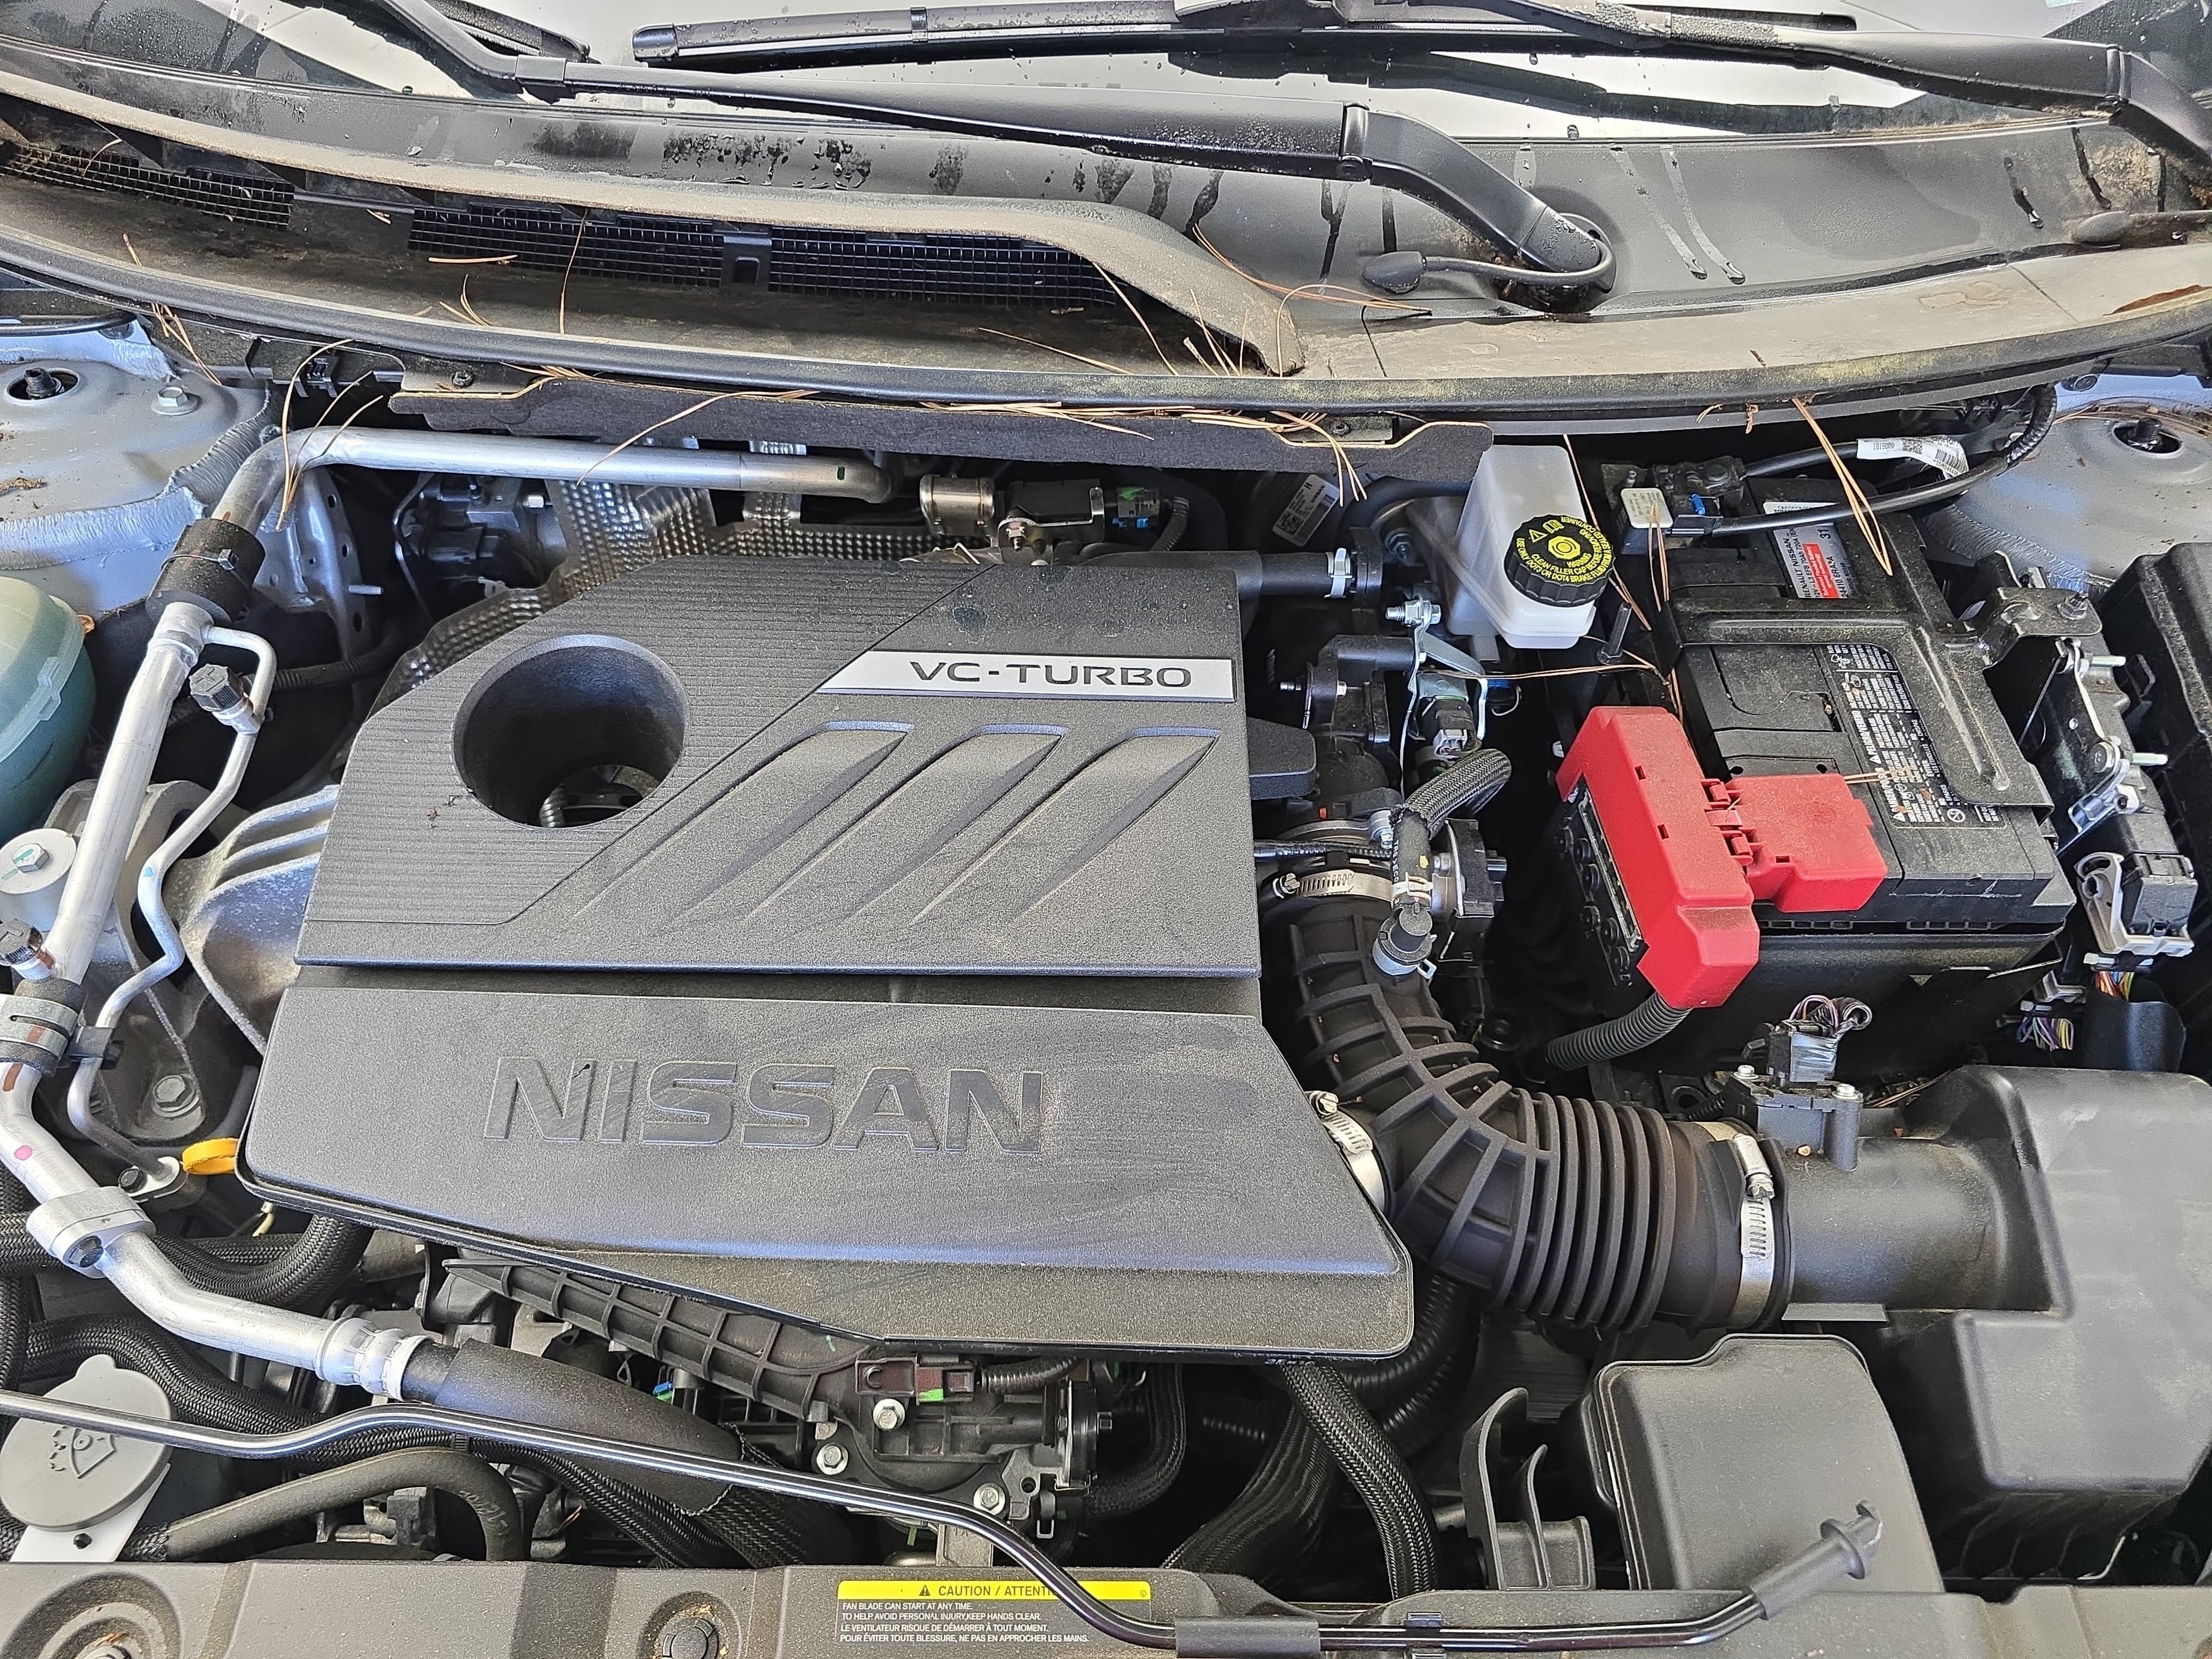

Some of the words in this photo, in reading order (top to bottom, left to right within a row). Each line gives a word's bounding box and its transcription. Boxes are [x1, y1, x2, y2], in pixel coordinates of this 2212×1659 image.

[1561, 516, 1596, 533] CONTAINER
[1593, 532, 1610, 549] SEALED
[1817, 529, 1831, 539] 31
[1516, 538, 1525, 548] USE
[1518, 548, 1531, 561] ONLY
[1783, 538, 1799, 567] NISSAN
[1526, 559, 1542, 573] DOT3
[1531, 554, 1551, 569] CLEAN
[1550, 565, 1574, 575] FILLER
[1574, 566, 1586, 575] CAP
[1585, 552, 1602, 570] BEFORE
[1566, 553, 1592, 568] WARNING
[1601, 554, 1612, 568] FROM
[1541, 569, 1552, 578] OR
[1552, 573, 1570, 582] DOT4
[1570, 573, 1593, 582] BRAKE
[1590, 565, 1606, 578] FLUID
[1795, 570, 1812, 597] RENAULT
[1835, 579, 1848, 598] 24410
[909, 661, 1193, 688] VC-TURBO
[1850, 710, 1878, 755] PELIGRO/VENENO
[483, 1056, 1045, 1155] NISSAN
[938, 1586, 991, 1596] CAUTION
[995, 1586, 1001, 1596] /
[1005, 1586, 1052, 1596] ATTENTI
[943, 1622, 985, 1631] DÉMARRER
[986, 1622, 992, 1631] À
[864, 1632, 889, 1642] ÉVITER
